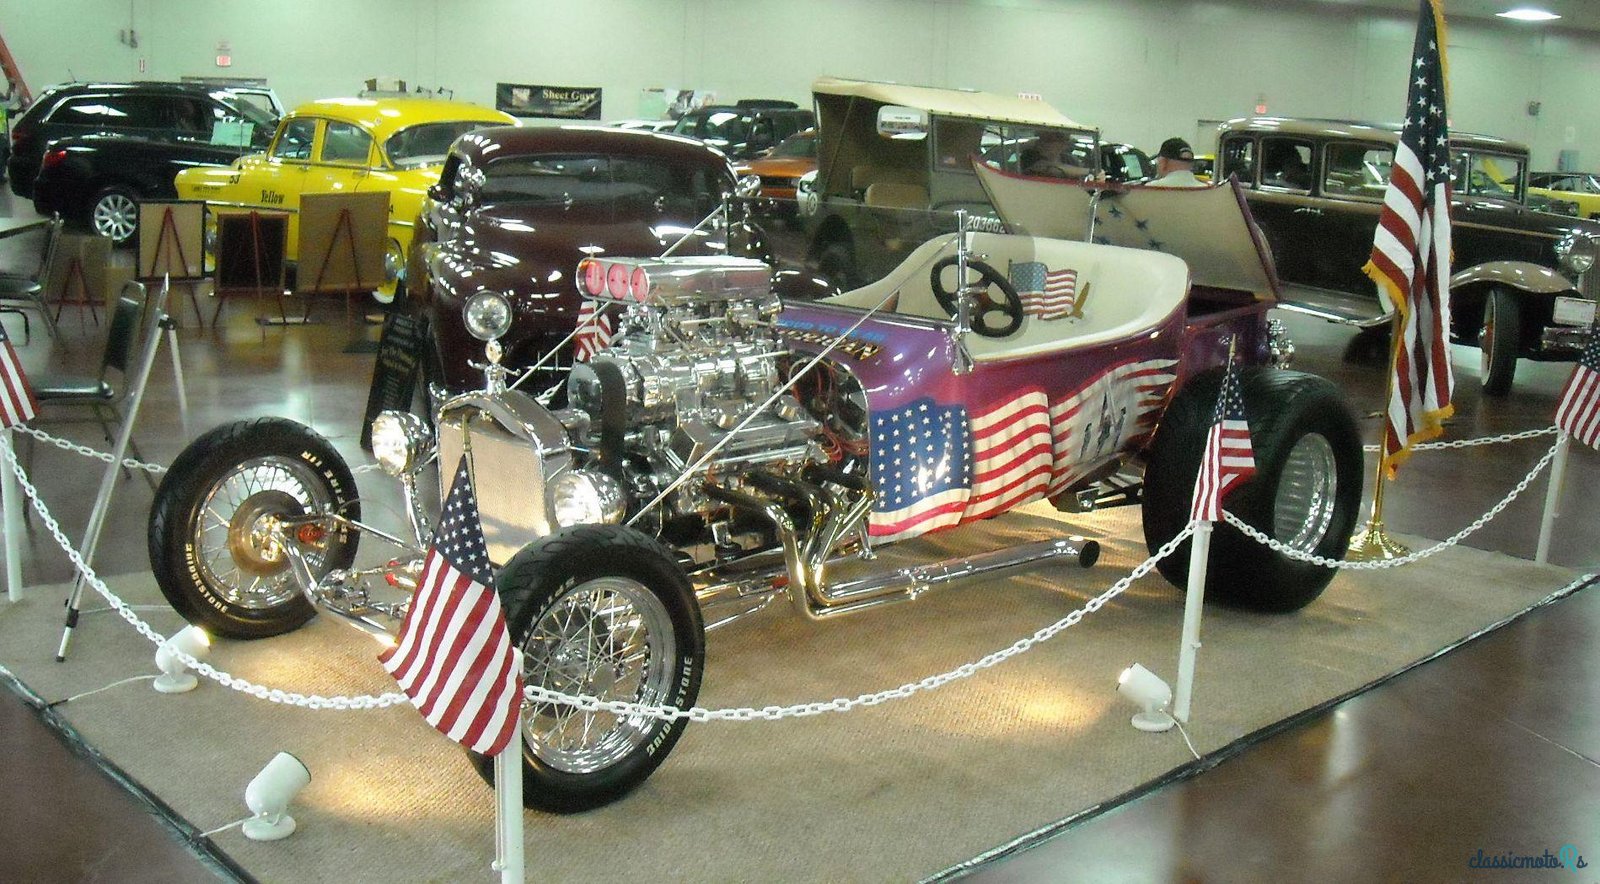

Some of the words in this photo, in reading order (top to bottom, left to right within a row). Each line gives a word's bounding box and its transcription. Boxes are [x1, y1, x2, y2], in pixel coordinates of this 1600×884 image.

[542, 89, 570, 100] Sheet
[571, 91, 596, 103] Guys
[260, 189, 286, 205] Yellow
[185, 543, 229, 614] BRIDGESTONE
[645, 655, 693, 757] BRIDSTONE
